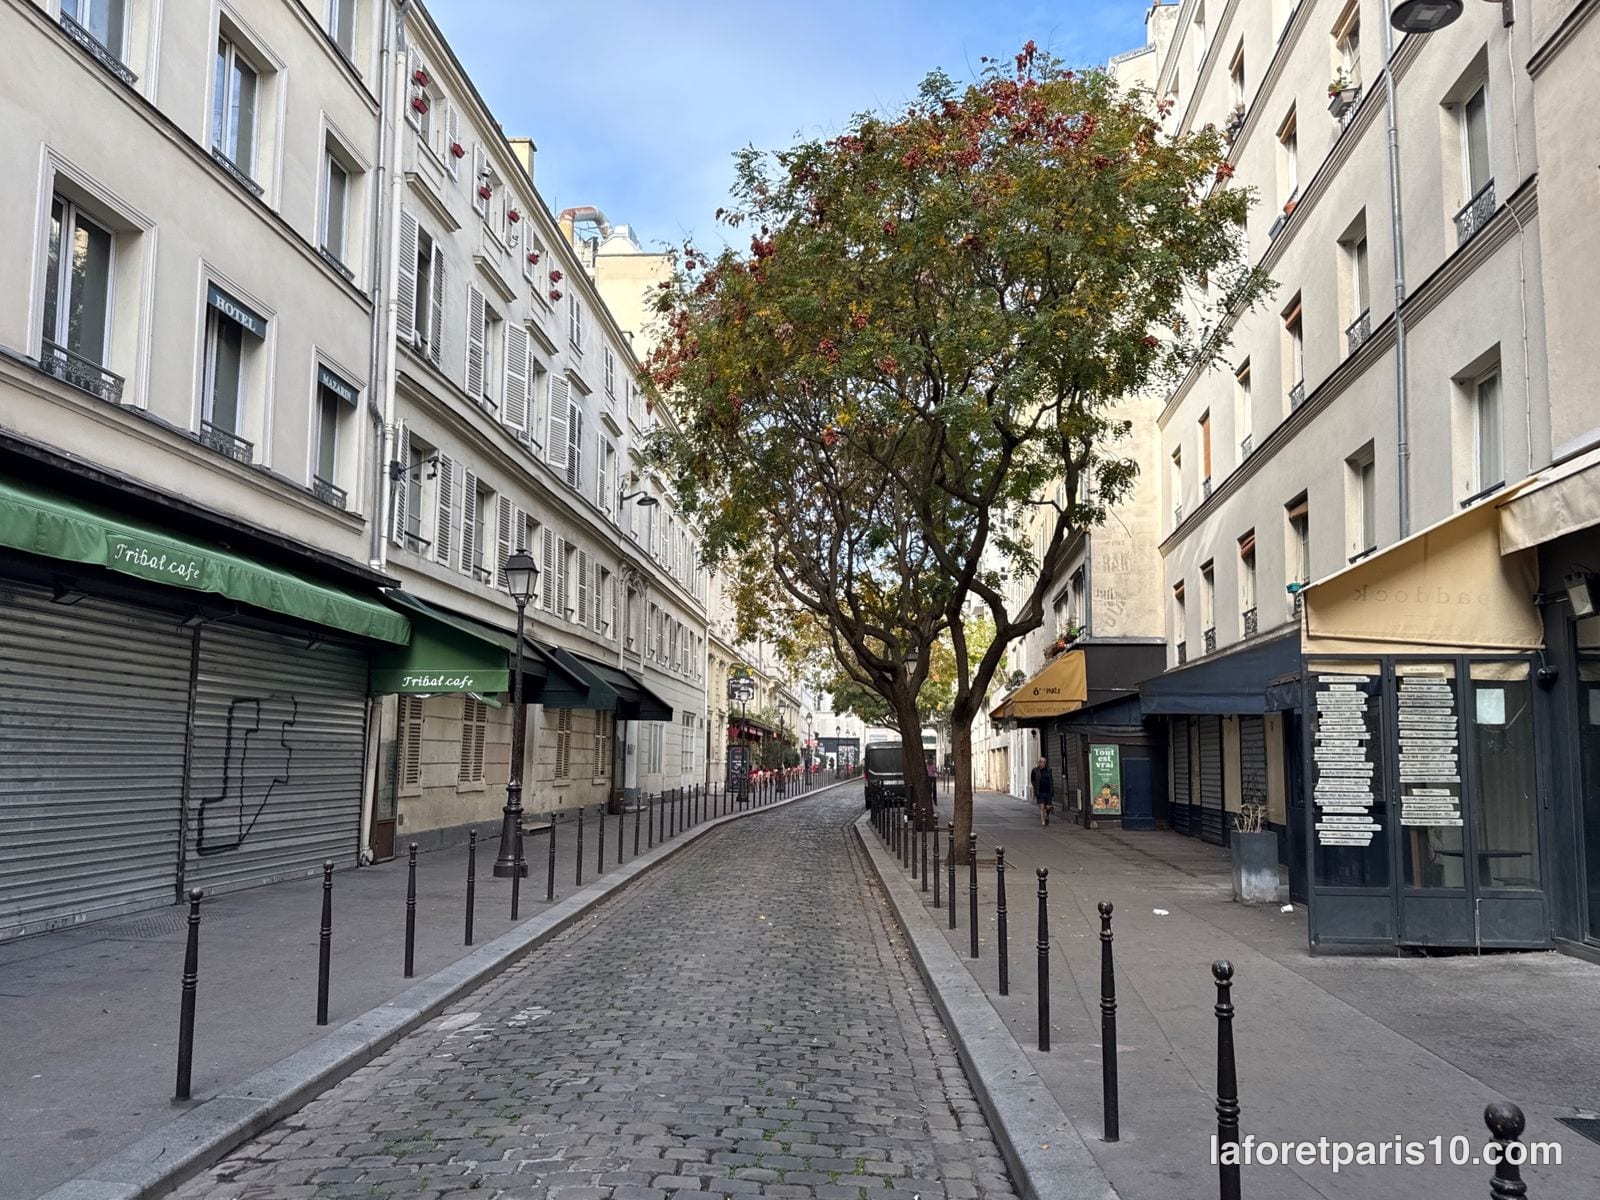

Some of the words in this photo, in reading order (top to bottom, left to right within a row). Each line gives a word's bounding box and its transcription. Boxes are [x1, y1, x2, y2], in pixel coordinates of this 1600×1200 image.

[215, 294, 256, 332] HOTEL
[322, 373, 353, 400] MAZARIN
[114, 543, 167, 570] Tribal
[167, 561, 200, 581] cafe
[402, 675, 444, 687] Tribal
[444, 675, 474, 688] cafe
[1094, 748, 1115, 756] Tout
